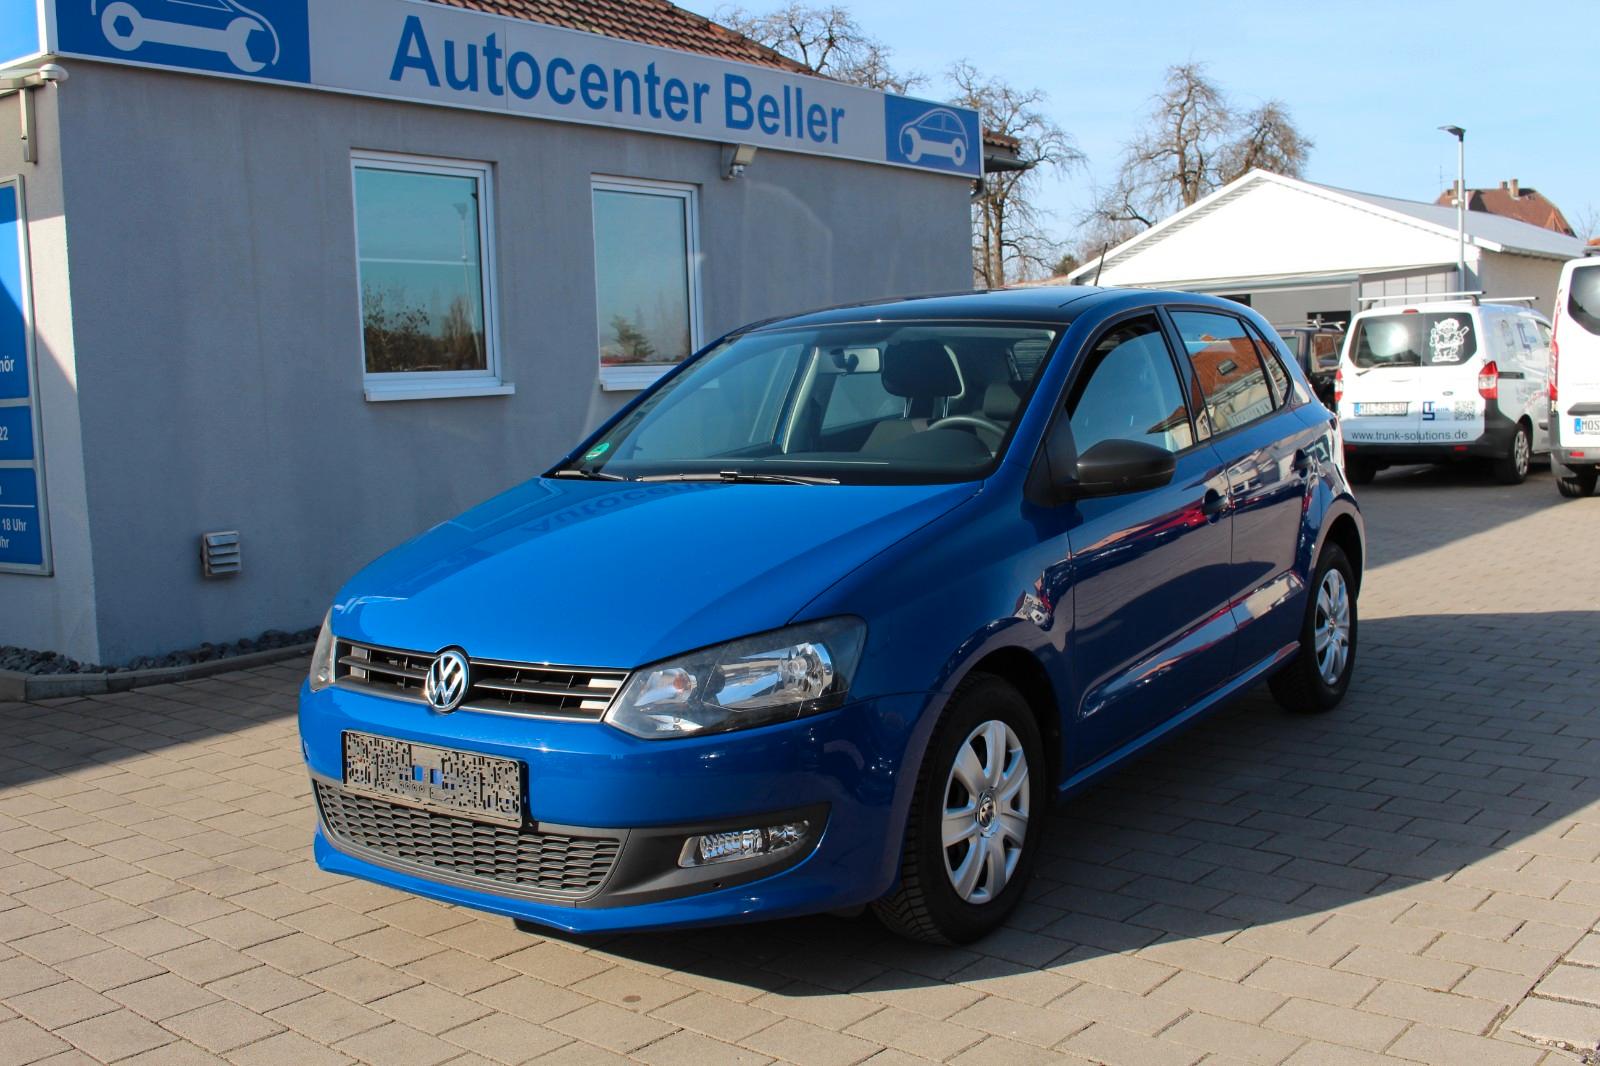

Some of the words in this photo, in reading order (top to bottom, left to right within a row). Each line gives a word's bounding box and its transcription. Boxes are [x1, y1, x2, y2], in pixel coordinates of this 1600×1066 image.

[389, 15, 710, 124] Autocenter
[723, 73, 845, 144] Beller
[1351, 430, 1468, 441] www.trunk-solutions.de
[1, 518, 12, 531] 18
[12, 518, 27, 532] Uhr
